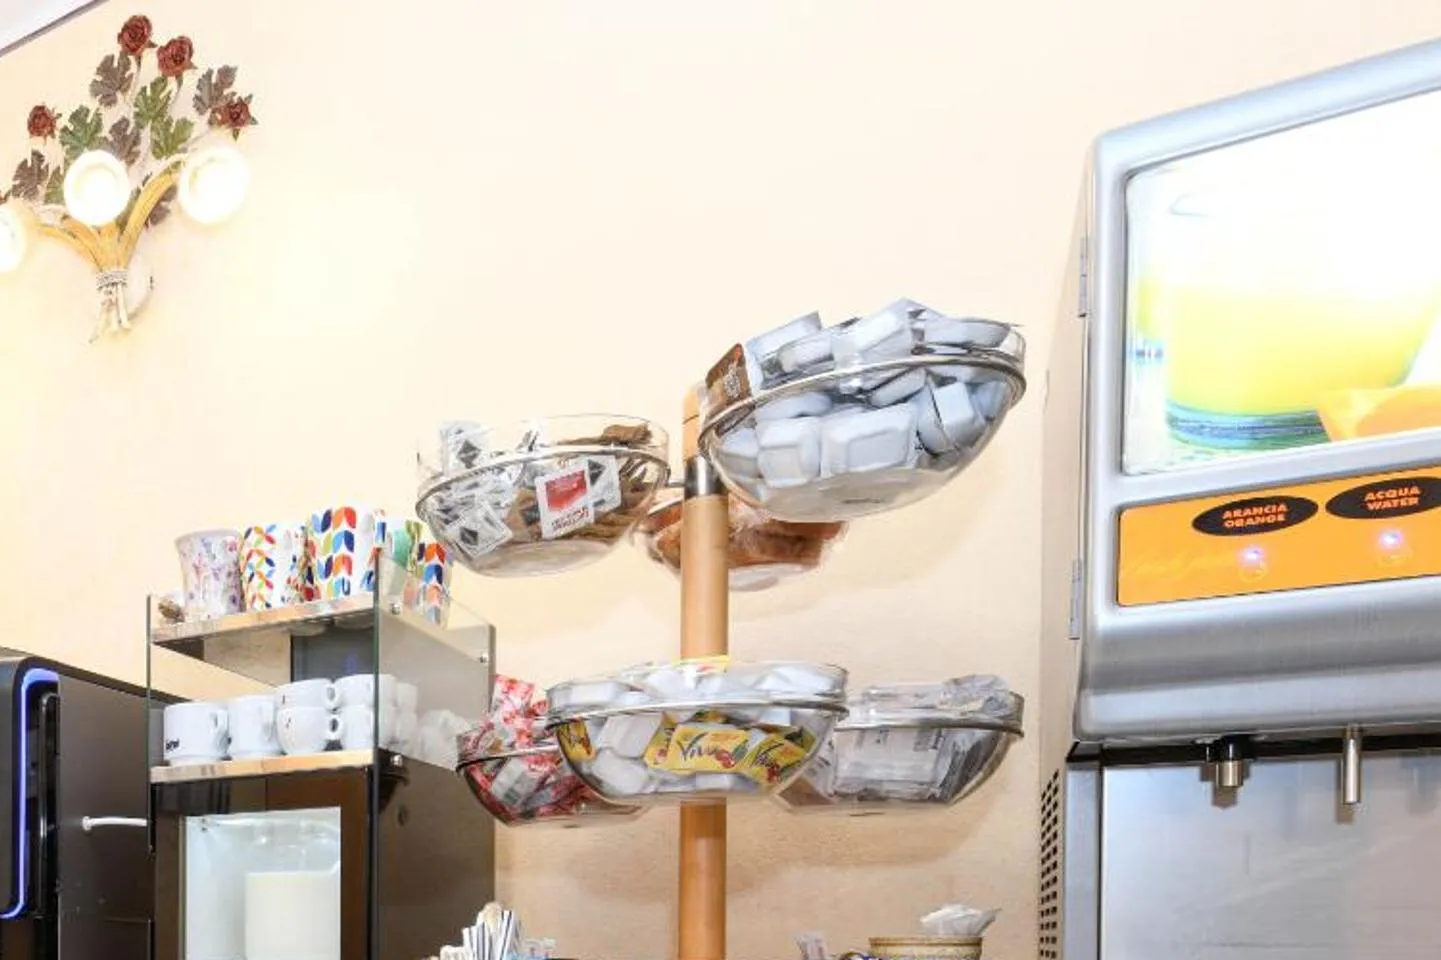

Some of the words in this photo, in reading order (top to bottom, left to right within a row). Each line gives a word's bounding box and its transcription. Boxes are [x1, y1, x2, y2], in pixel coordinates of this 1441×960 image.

[1365, 486, 1420, 501] ACQUA
[1366, 497, 1420, 511] WATER
[1223, 504, 1287, 519] ARANCIA
[1223, 514, 1286, 528] ORANGE
